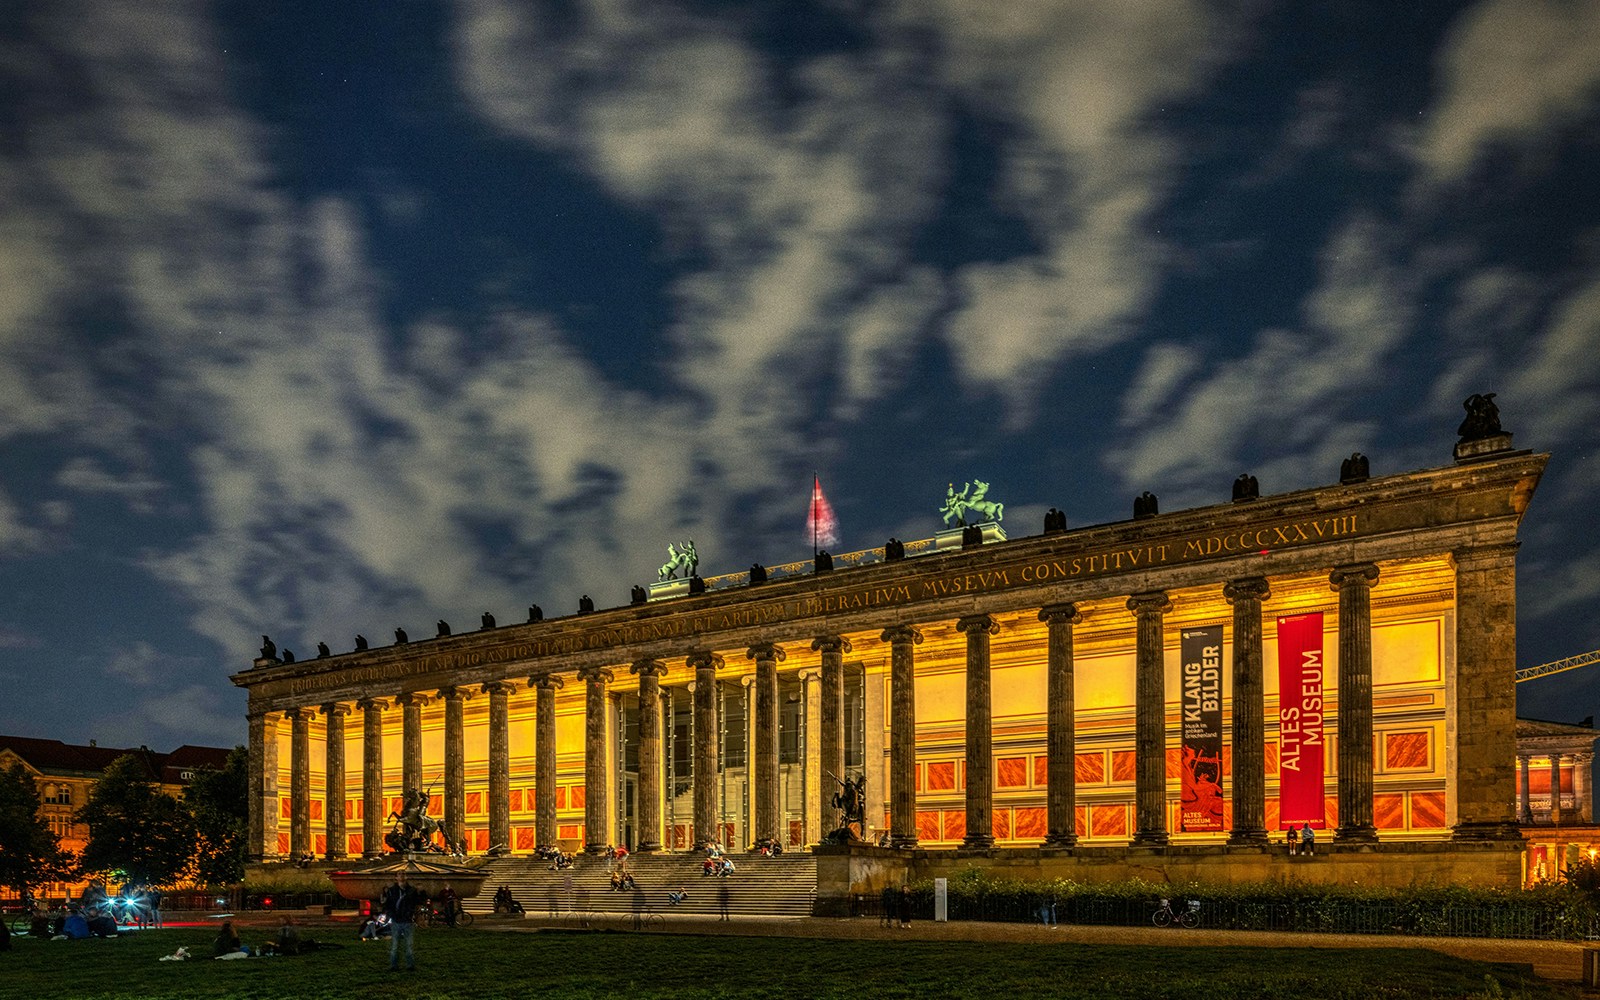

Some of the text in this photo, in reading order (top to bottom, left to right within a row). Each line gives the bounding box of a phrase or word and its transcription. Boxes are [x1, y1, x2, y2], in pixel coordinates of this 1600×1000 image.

[416, 658, 429, 673] III
[436, 653, 481, 669] STVDIO
[487, 637, 584, 662] ANTIQVITATIS
[694, 616, 715, 631] ET
[720, 603, 786, 628] ARTIVM
[795, 585, 912, 616] LIBERALIVM
[921, 570, 1010, 597] MVSEVM
[1021, 545, 1171, 582] CONSTITVIT
[1183, 515, 1358, 558] MDCCCXXVIII
[1185, 662, 1202, 722] KLANG
[1202, 645, 1219, 712] BILDER
[1302, 650, 1322, 745] MUSEUM
[1281, 707, 1300, 771] ALTES
